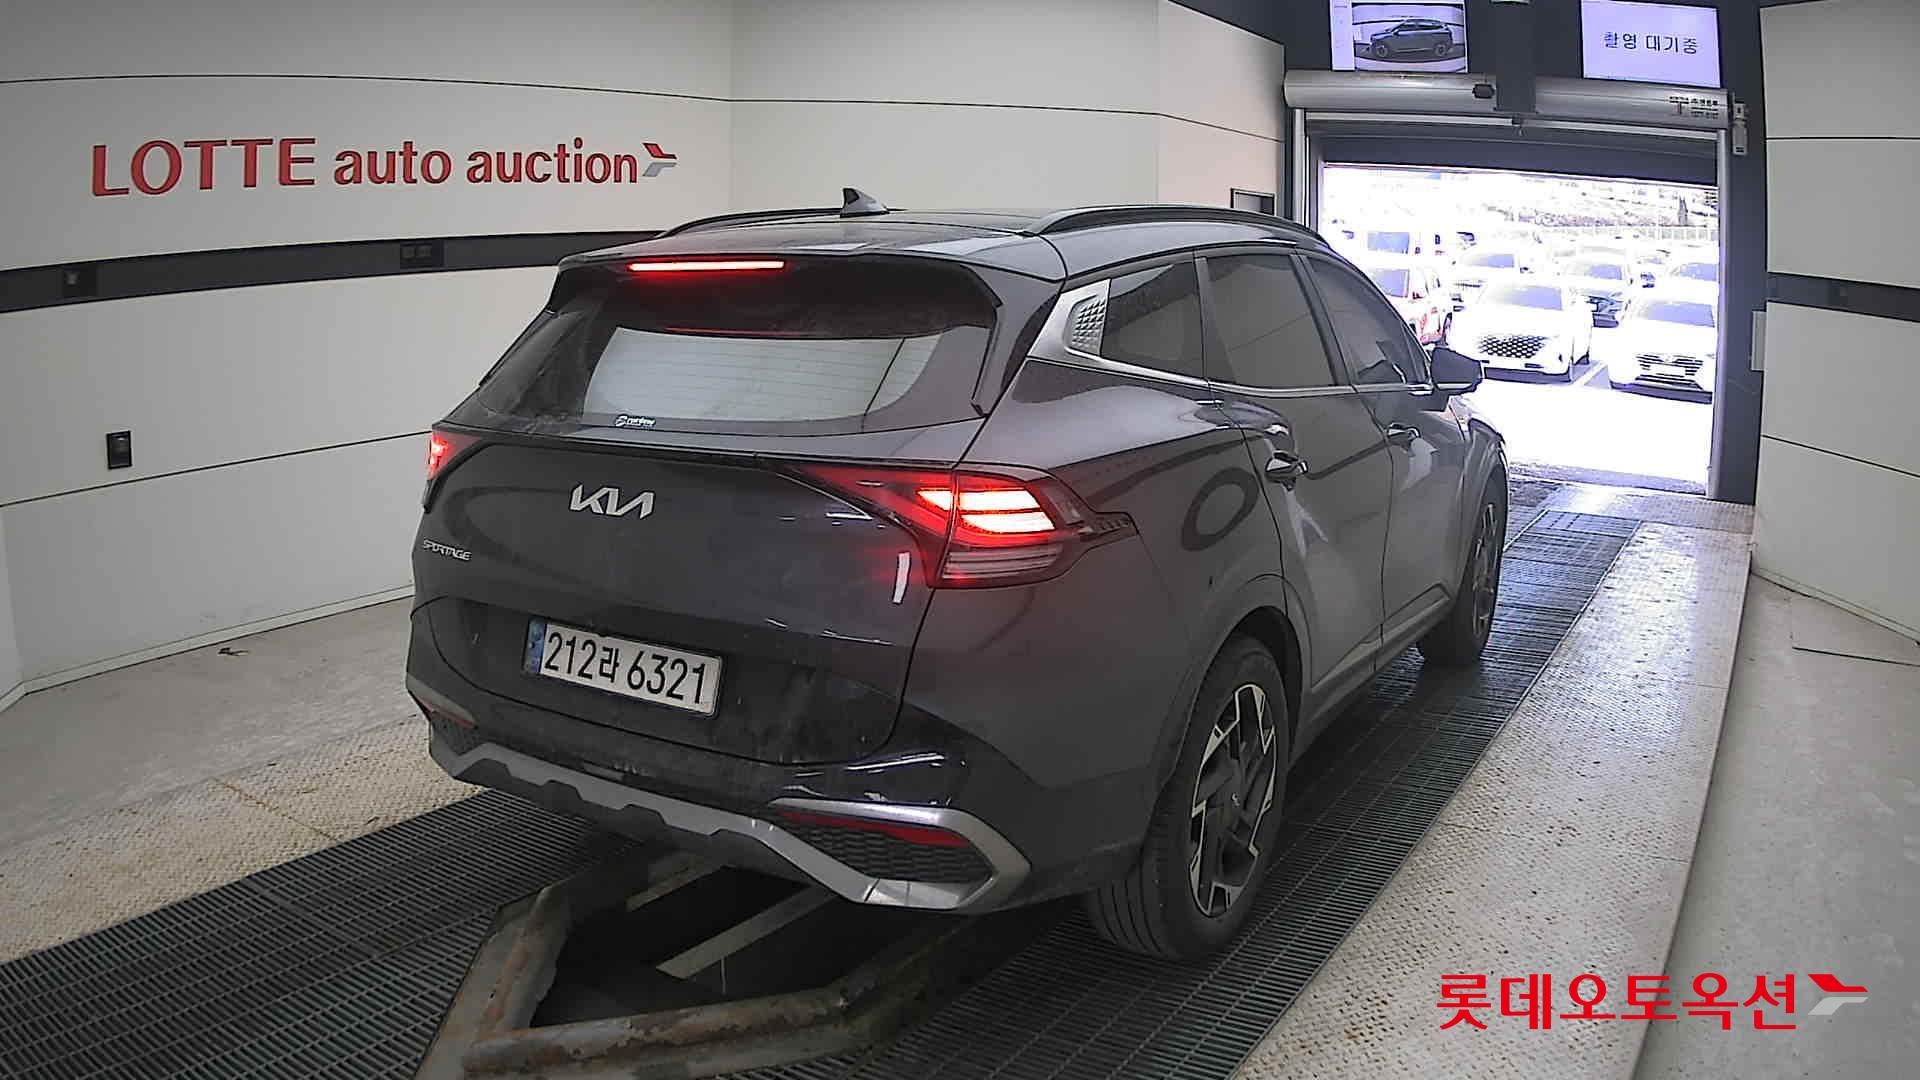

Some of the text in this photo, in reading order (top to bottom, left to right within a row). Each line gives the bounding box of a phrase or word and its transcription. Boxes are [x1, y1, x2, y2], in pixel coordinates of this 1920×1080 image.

[1646, 35, 1697, 54] 대기중
[92, 137, 638, 196] LOTTE auto auction
[570, 484, 654, 519] KIA
[544, 632, 706, 704] 212라 6321
